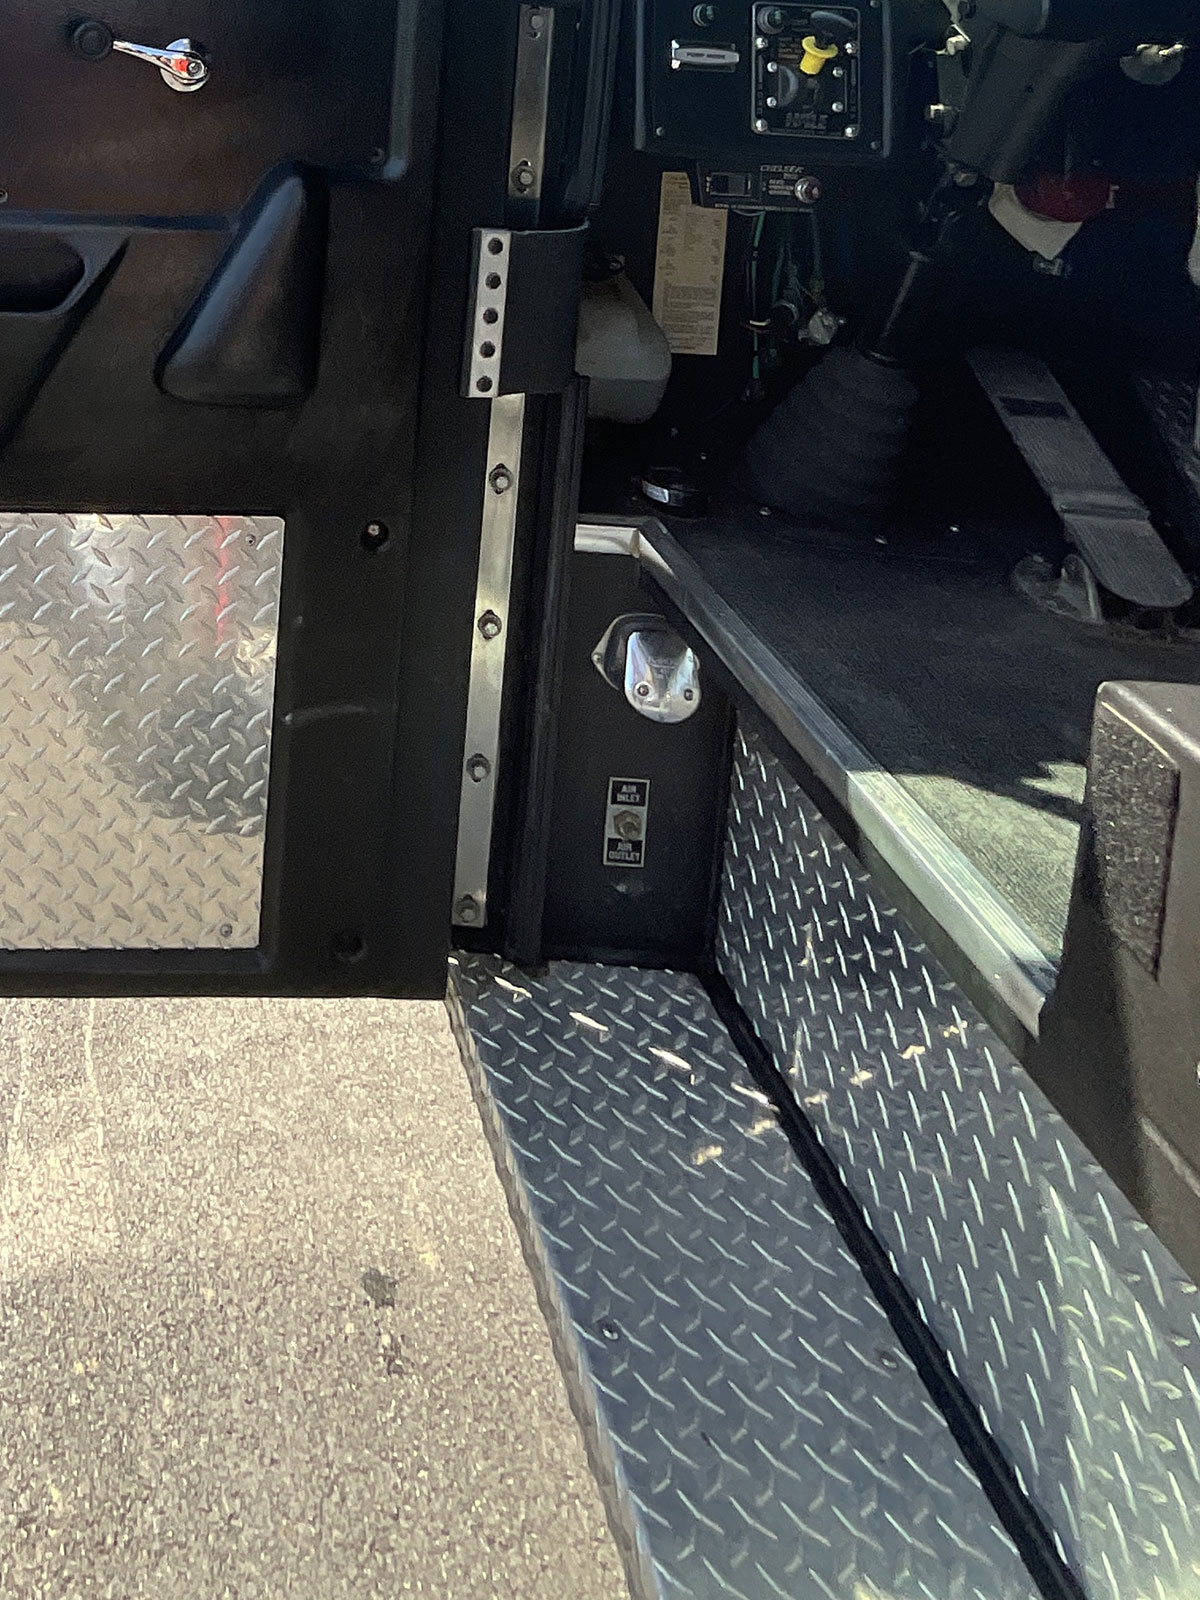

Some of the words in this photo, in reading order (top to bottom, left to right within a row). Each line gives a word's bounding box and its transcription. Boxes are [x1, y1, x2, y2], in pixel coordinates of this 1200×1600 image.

[621, 784, 637, 793] AIR
[616, 793, 641, 803] INLET
[616, 841, 633, 851] AIR
[608, 850, 641, 862] OUTLET
